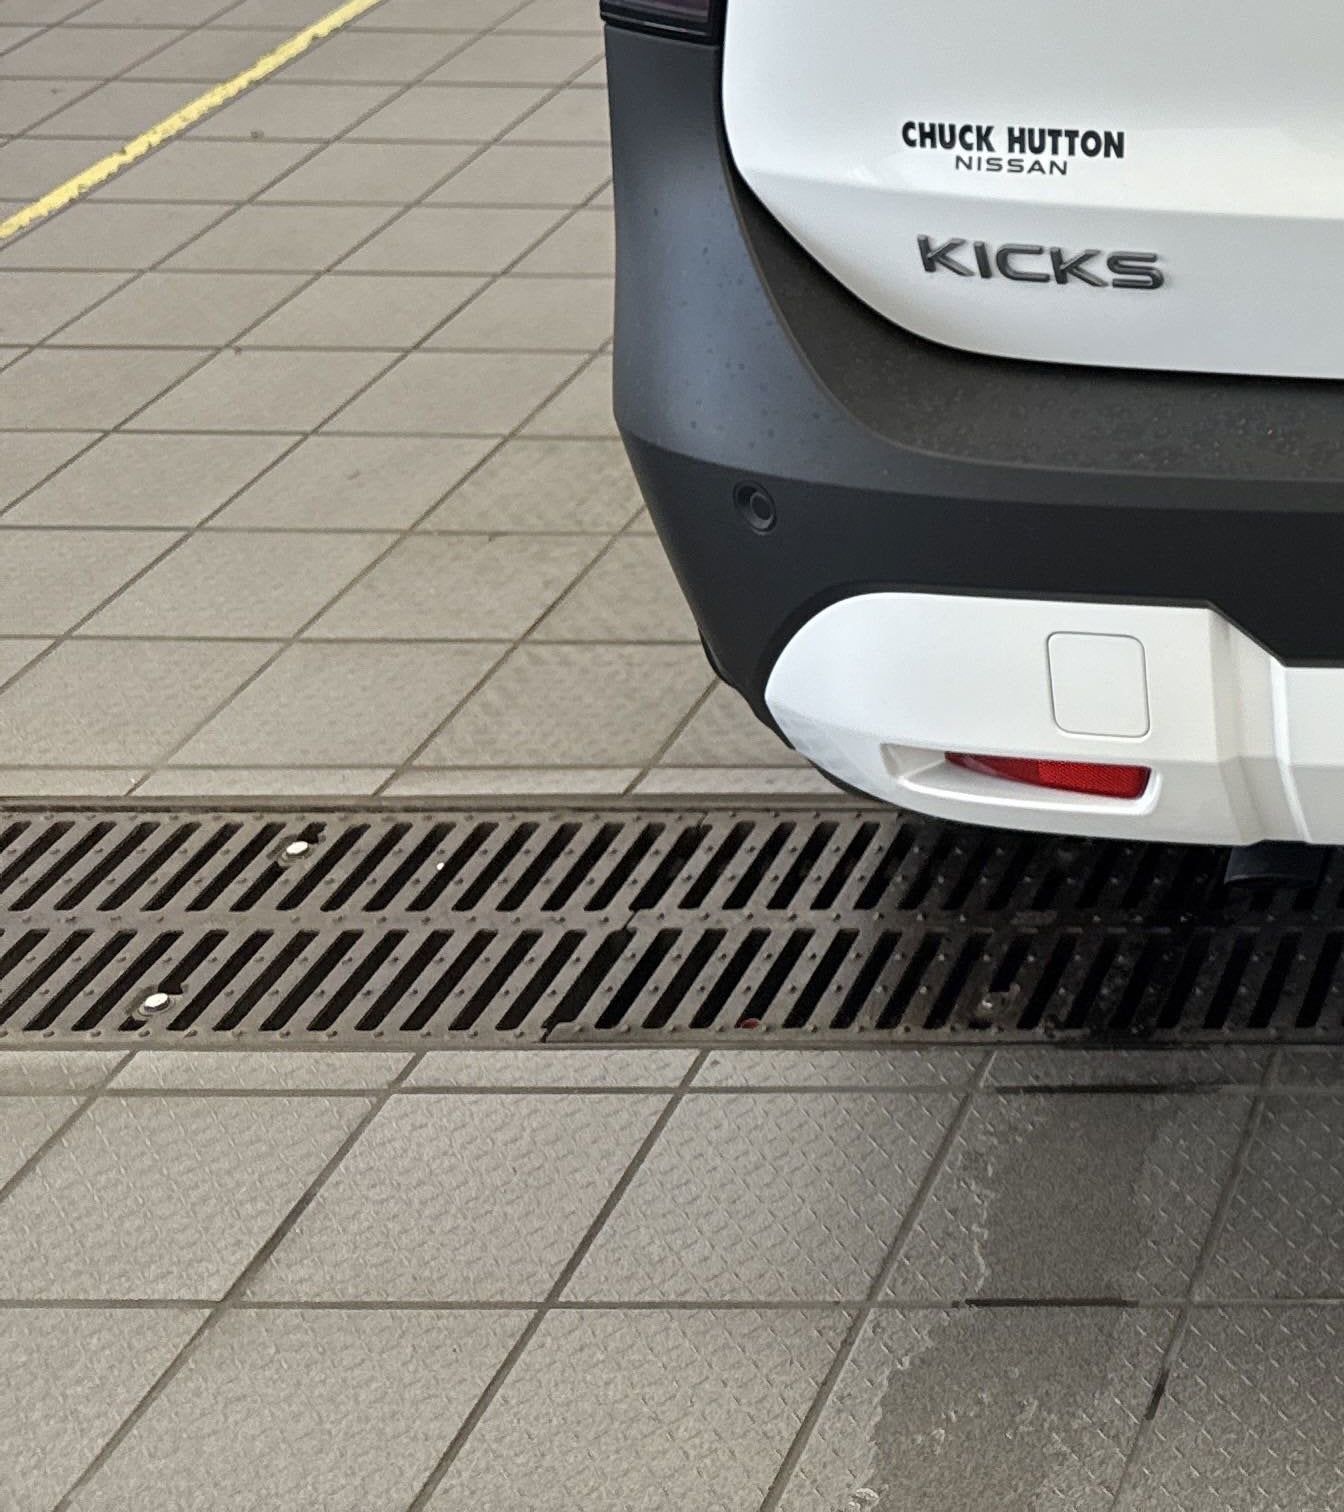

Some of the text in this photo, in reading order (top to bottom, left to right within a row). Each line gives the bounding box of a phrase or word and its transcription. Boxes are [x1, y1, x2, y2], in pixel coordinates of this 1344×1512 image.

[901, 121, 1125, 159] CHUCK HUTTON
[954, 155, 1068, 176] NISSAN
[917, 233, 1165, 290] KICKS
